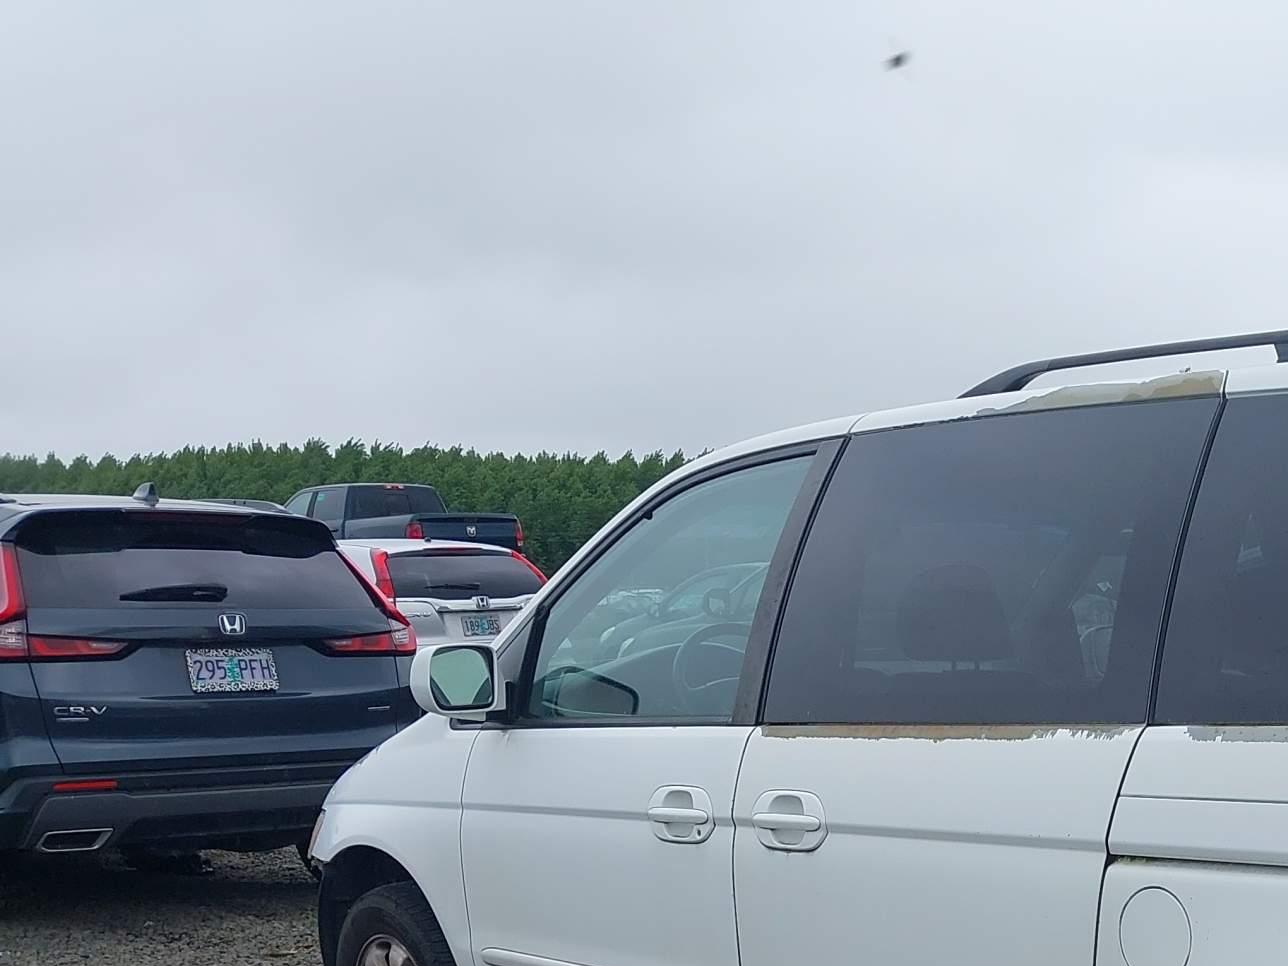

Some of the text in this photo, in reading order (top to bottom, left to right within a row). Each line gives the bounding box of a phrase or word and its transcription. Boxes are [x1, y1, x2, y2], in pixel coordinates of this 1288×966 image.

[193, 658, 273, 681] 295 PFH
[53, 705, 107, 716] CR-V
